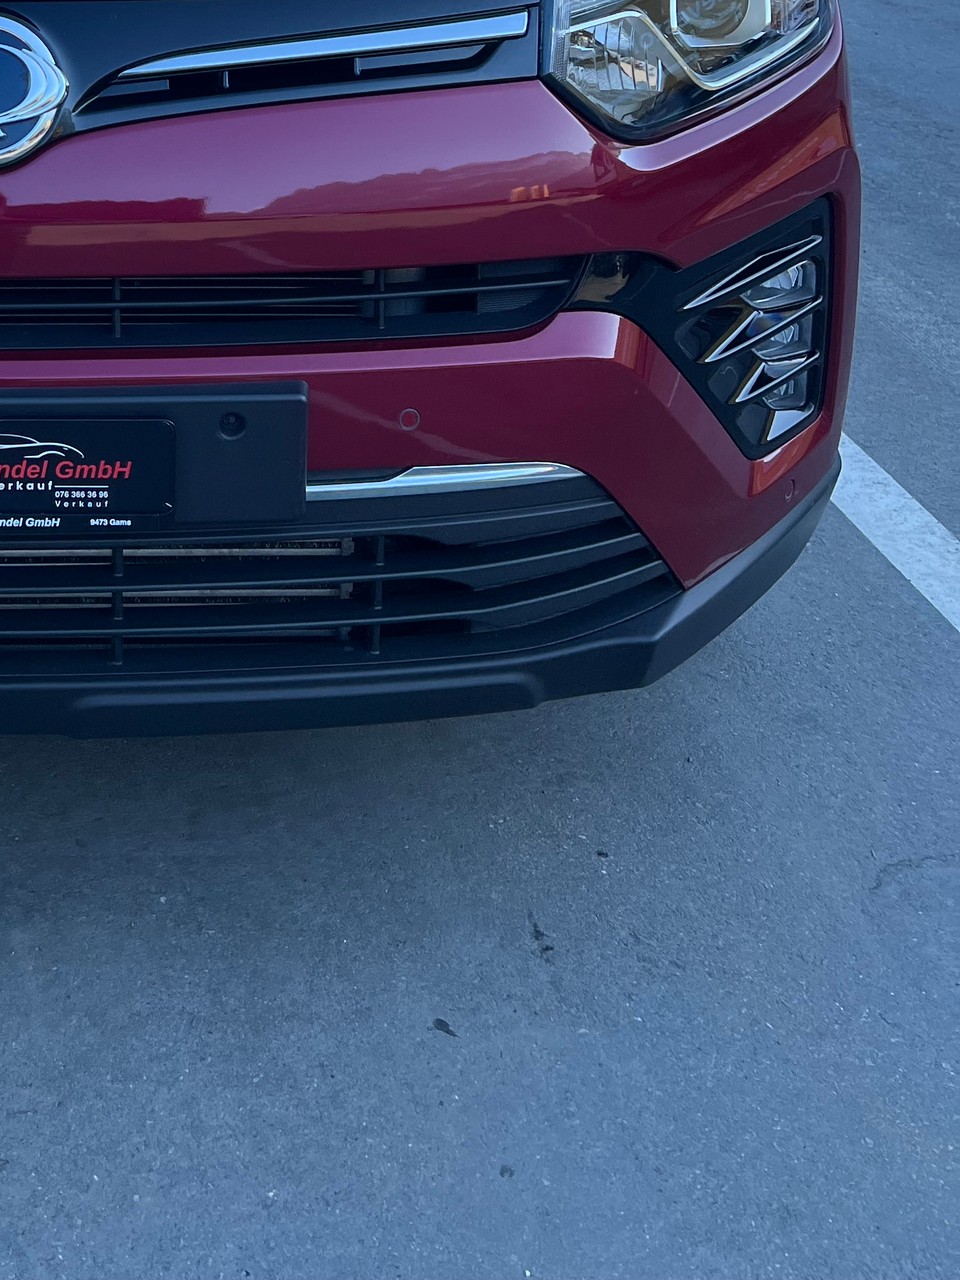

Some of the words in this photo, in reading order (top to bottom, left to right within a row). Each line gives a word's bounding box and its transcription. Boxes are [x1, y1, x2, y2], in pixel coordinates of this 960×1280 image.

[55, 460, 133, 479] GmbH
[54, 500, 109, 508] Verkauf
[25, 517, 61, 527] GmbH
